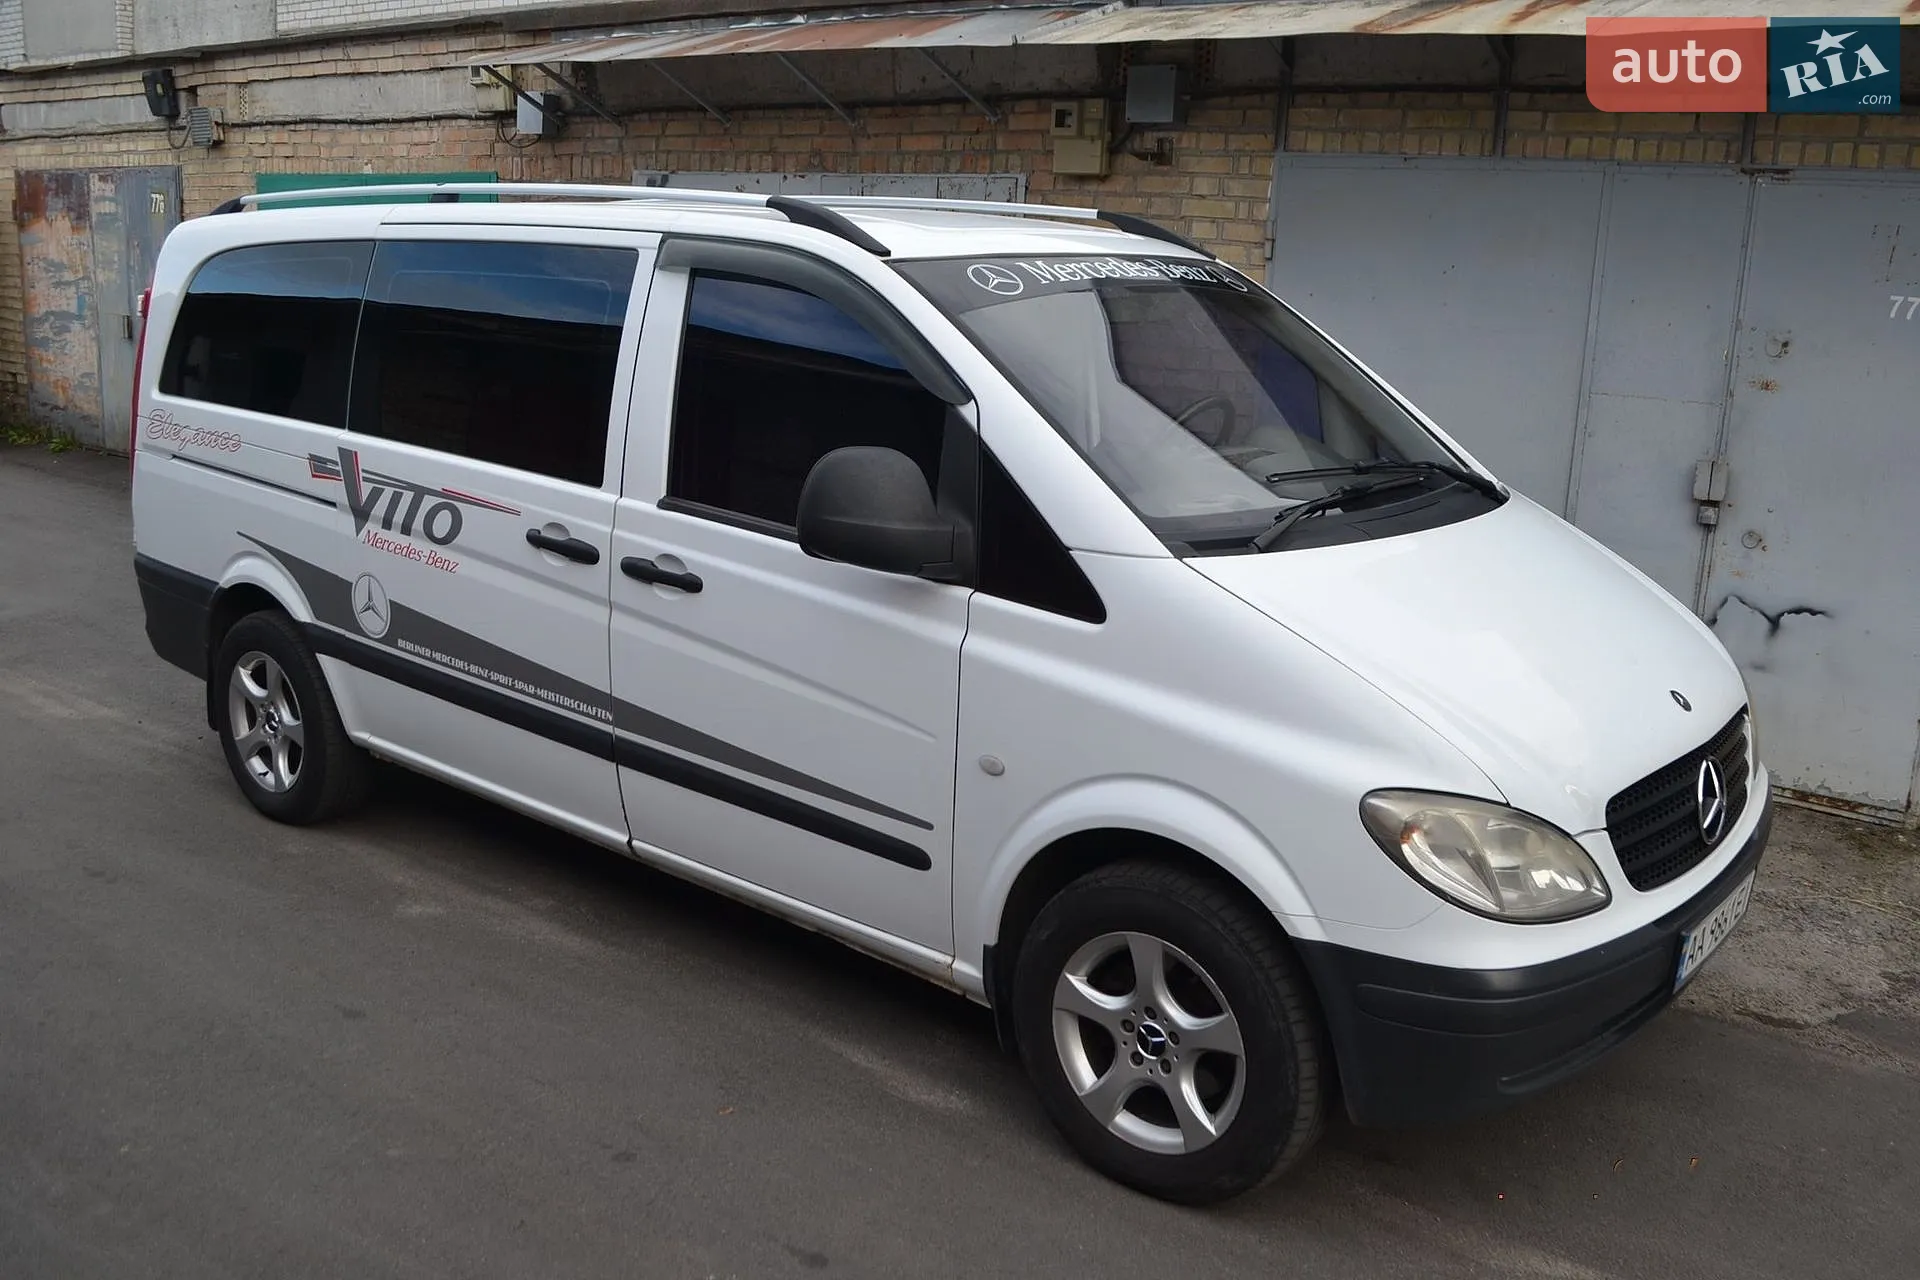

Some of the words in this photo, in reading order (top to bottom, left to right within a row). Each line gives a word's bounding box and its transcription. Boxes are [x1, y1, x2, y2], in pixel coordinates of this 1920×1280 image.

[1015, 257, 1217, 284] Mercedes-Benz
[147, 408, 241, 452] Elegance
[363, 529, 460, 574] Mercedes-Benz
[397, 638, 432, 658] BERLINER
